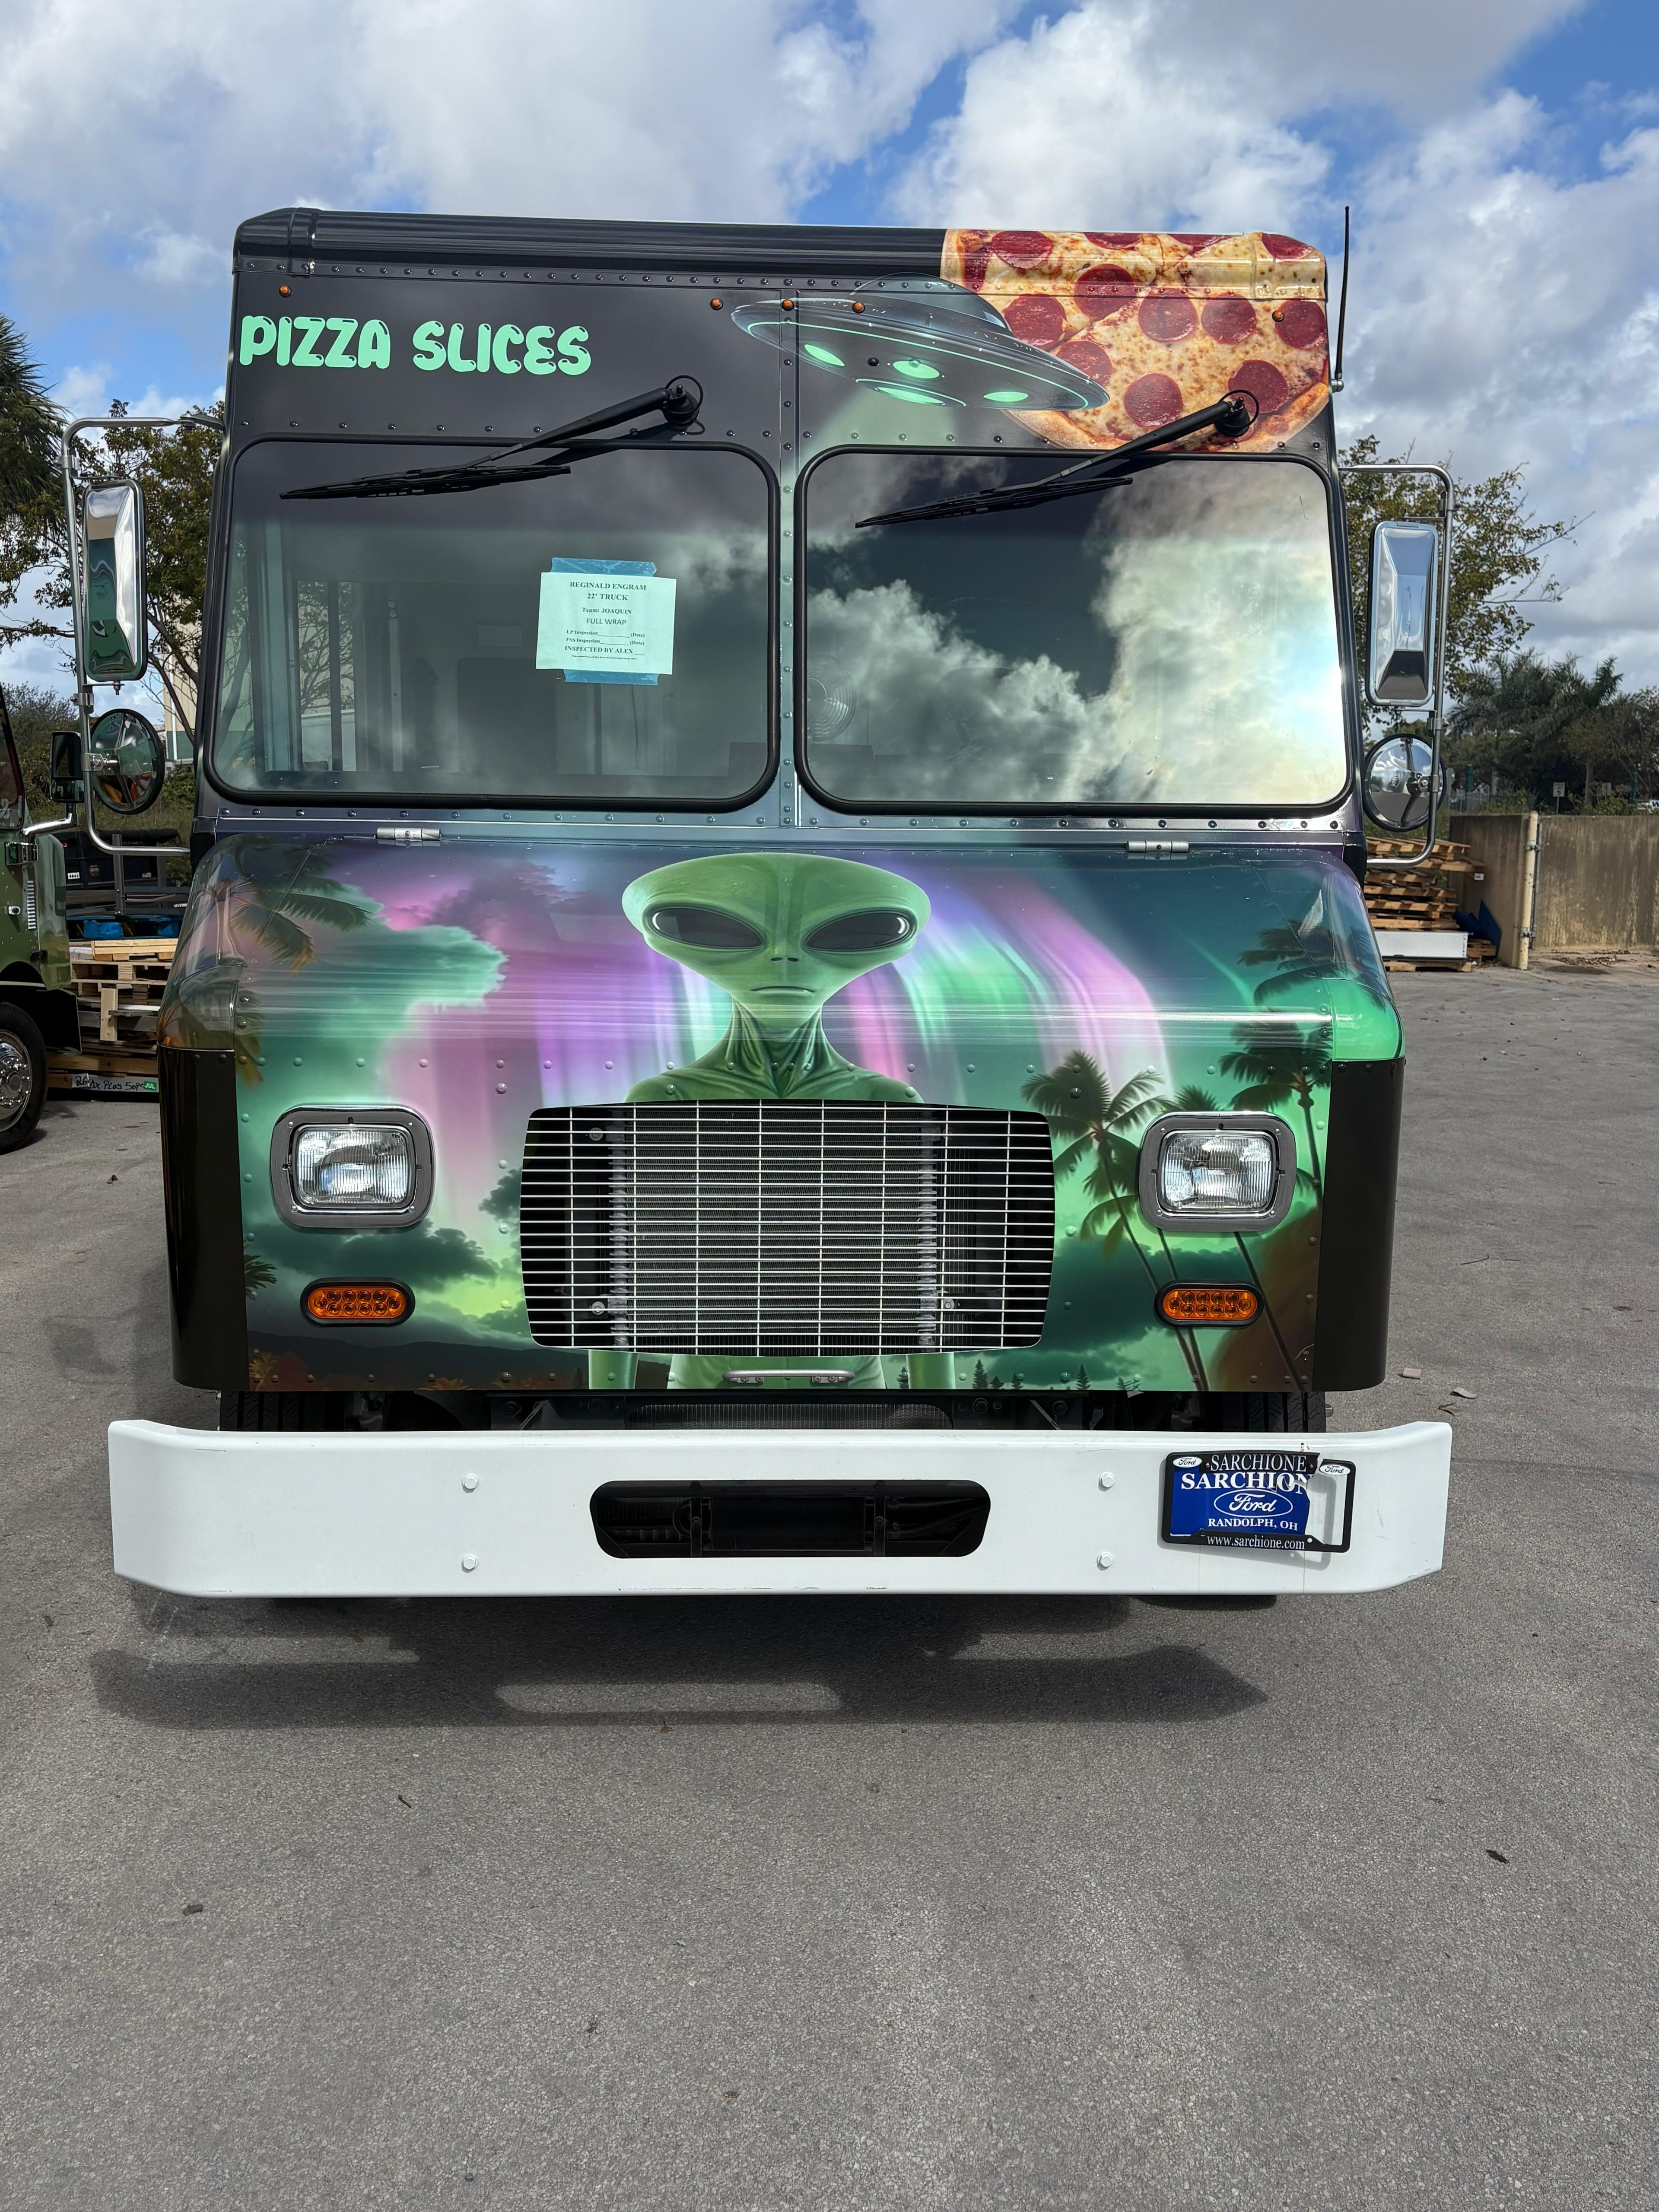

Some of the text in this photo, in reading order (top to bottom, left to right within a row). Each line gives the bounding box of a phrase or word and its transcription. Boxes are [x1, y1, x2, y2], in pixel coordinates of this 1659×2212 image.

[239, 316, 592, 375] PIZZA SLICES
[1210, 1454, 1307, 1472] SARCHIONE
[1325, 1465, 1345, 1474] Ford
[1229, 1493, 1277, 1513] Ford
[1208, 1518, 1298, 1531] RANDOLPH, OH
[1207, 1535, 1305, 1550] www.sarchione.com
